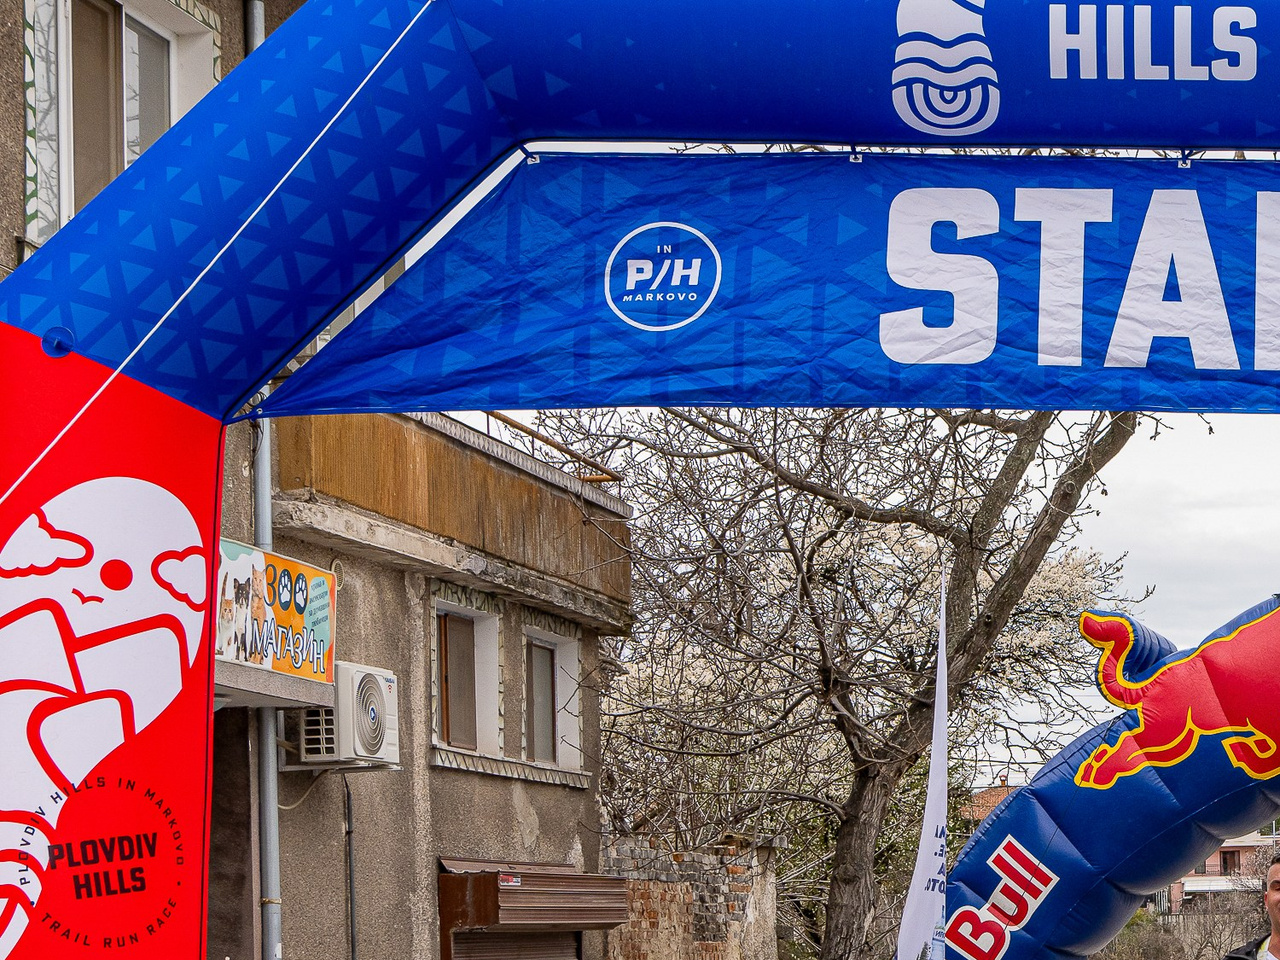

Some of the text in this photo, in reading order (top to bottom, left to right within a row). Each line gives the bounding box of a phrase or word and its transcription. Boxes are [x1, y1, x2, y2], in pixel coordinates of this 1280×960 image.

[1048, 4, 1258, 81] HILLS
[656, 245, 672, 254] IN
[626, 258, 702, 291] P/H
[623, 292, 698, 302] MARKOVO
[250, 617, 326, 674] МАГАЗИН
[18, 776, 184, 886] PLOVDIV HILLS IN MARKOVO
[47, 832, 158, 870] PLOVDIV
[72, 866, 147, 900] HILLS
[41, 897, 177, 949] TRAIL RUN RACE
